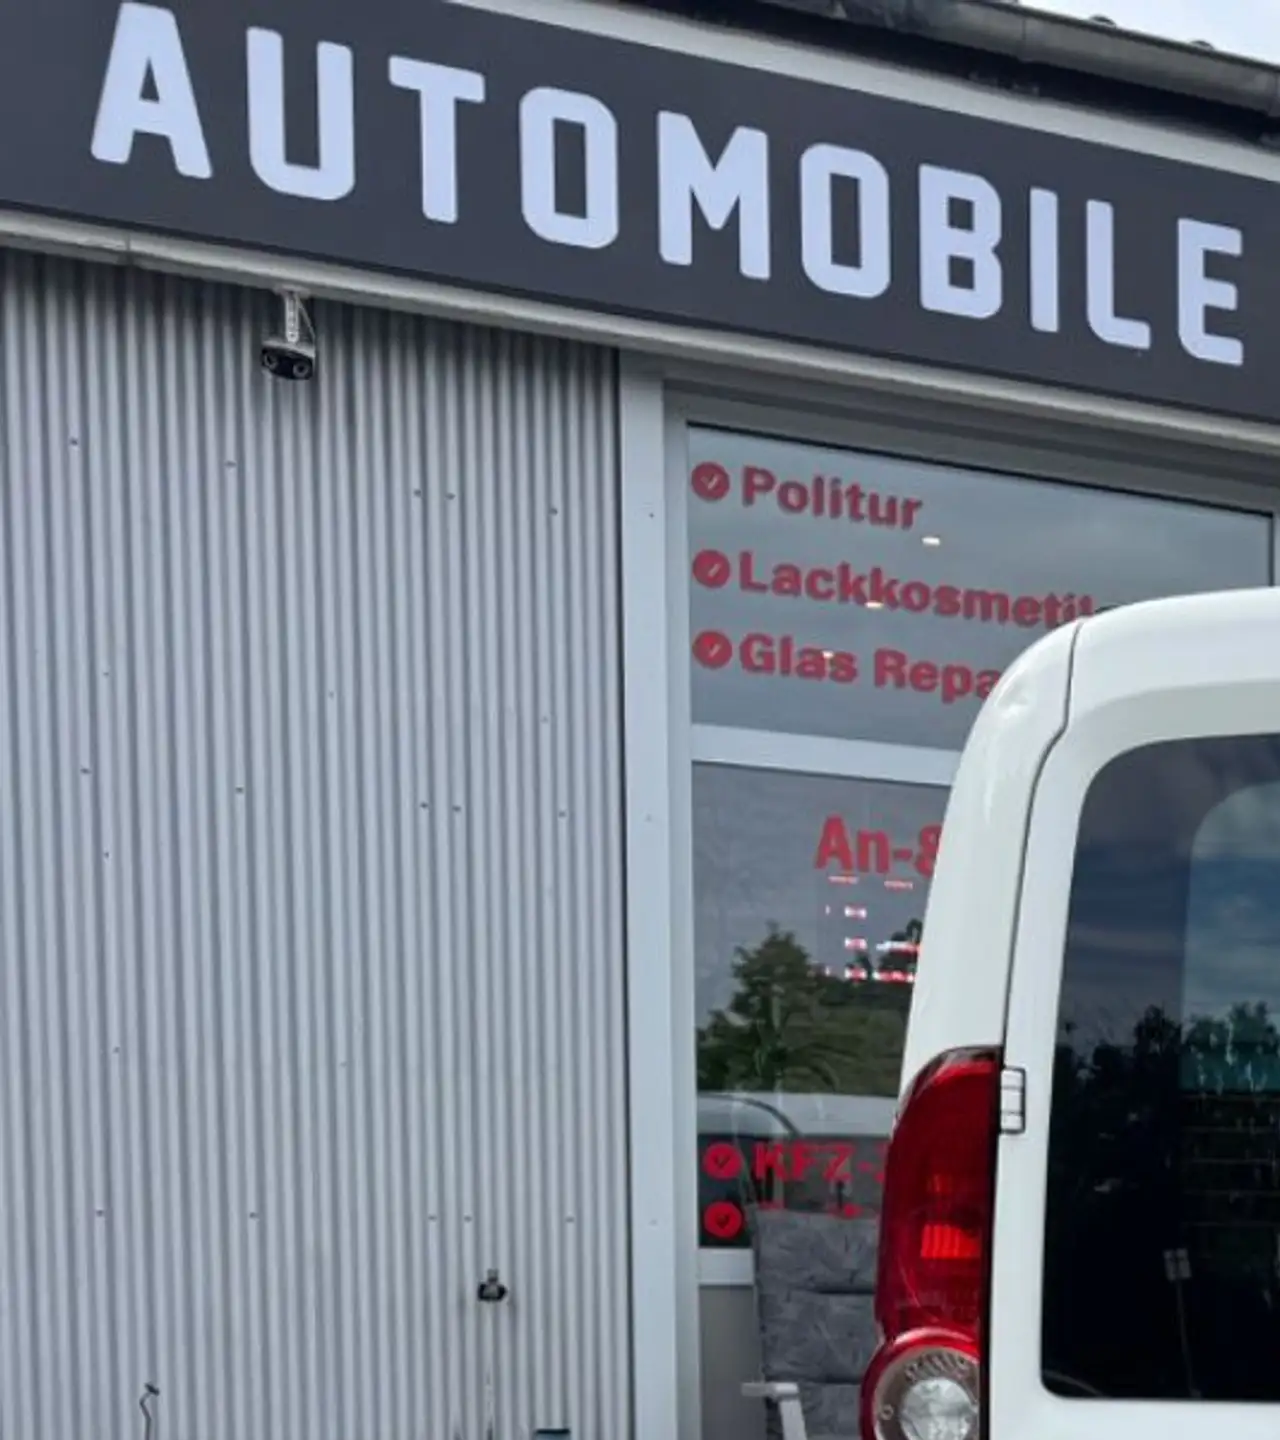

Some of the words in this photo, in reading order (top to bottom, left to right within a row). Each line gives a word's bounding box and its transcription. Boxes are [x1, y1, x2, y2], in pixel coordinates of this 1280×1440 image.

[91, 0, 1244, 366] AUTOMOBILE
[741, 464, 924, 530] Politur
[739, 632, 858, 684] Glas
